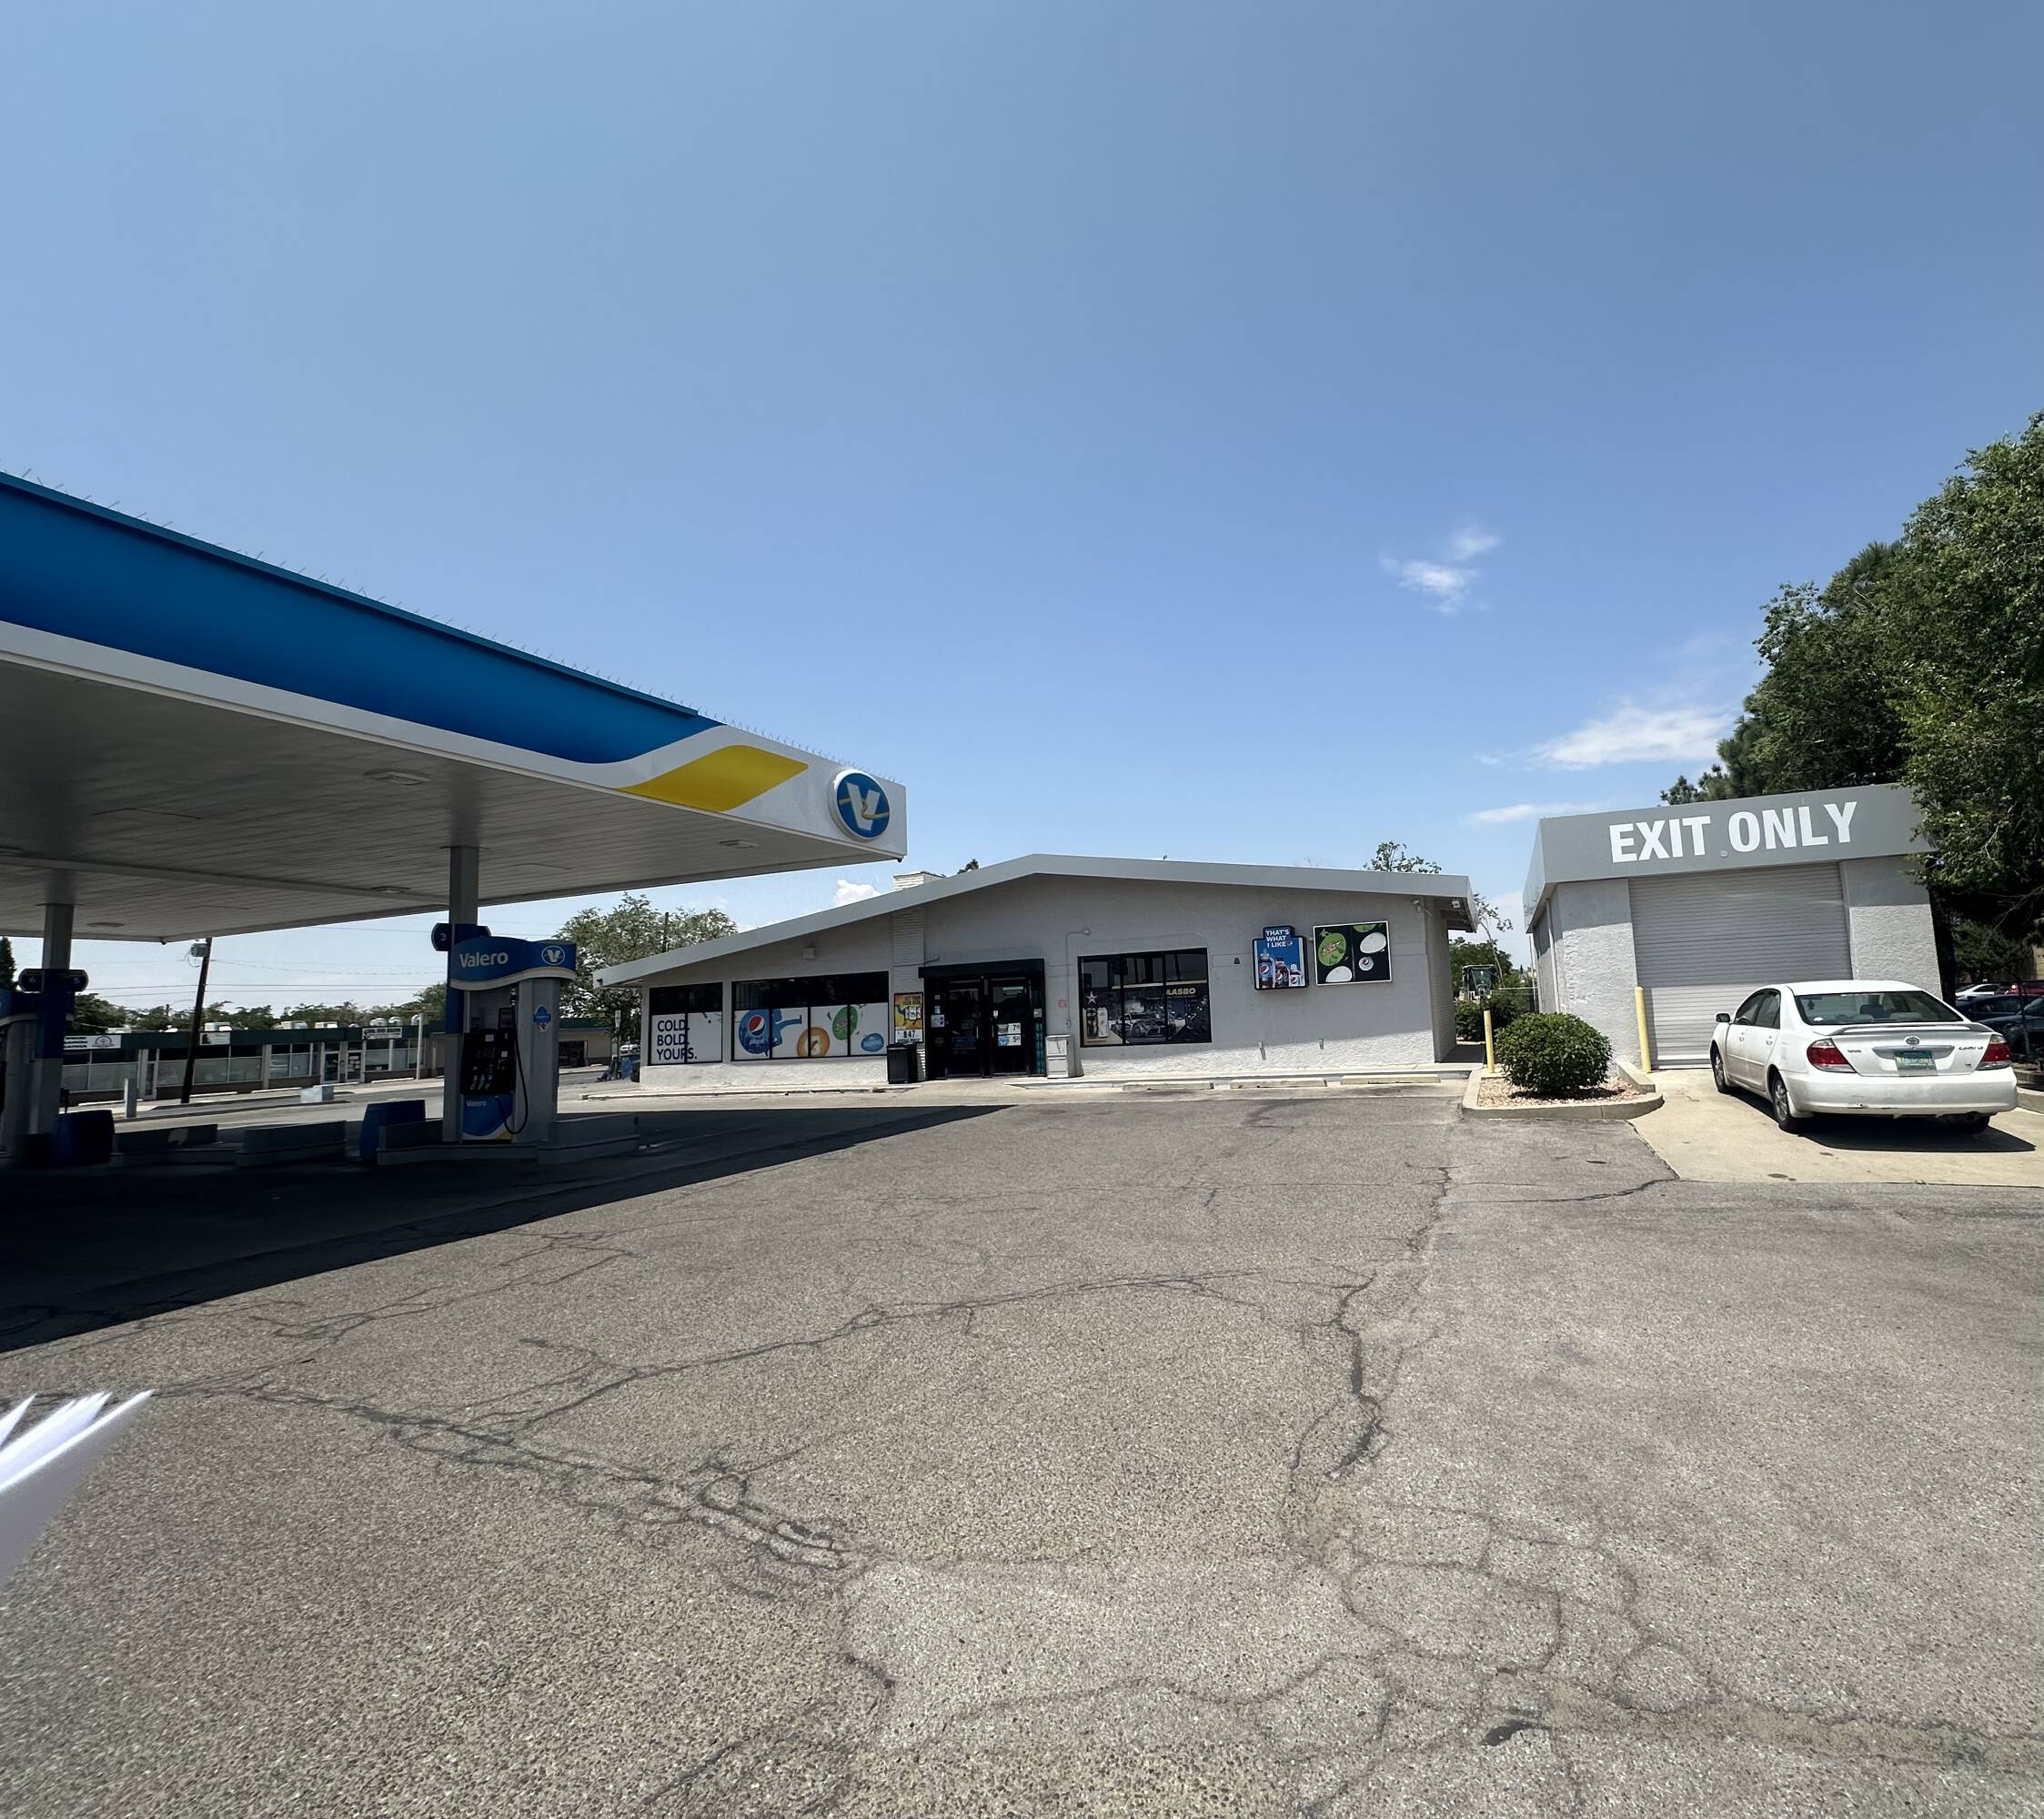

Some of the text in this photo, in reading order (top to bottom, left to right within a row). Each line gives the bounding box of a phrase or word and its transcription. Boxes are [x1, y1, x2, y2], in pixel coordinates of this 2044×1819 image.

[1609, 801, 1858, 863] EXIT ONLY
[440, 933, 447, 941] 3
[459, 950, 509, 968] Valero
